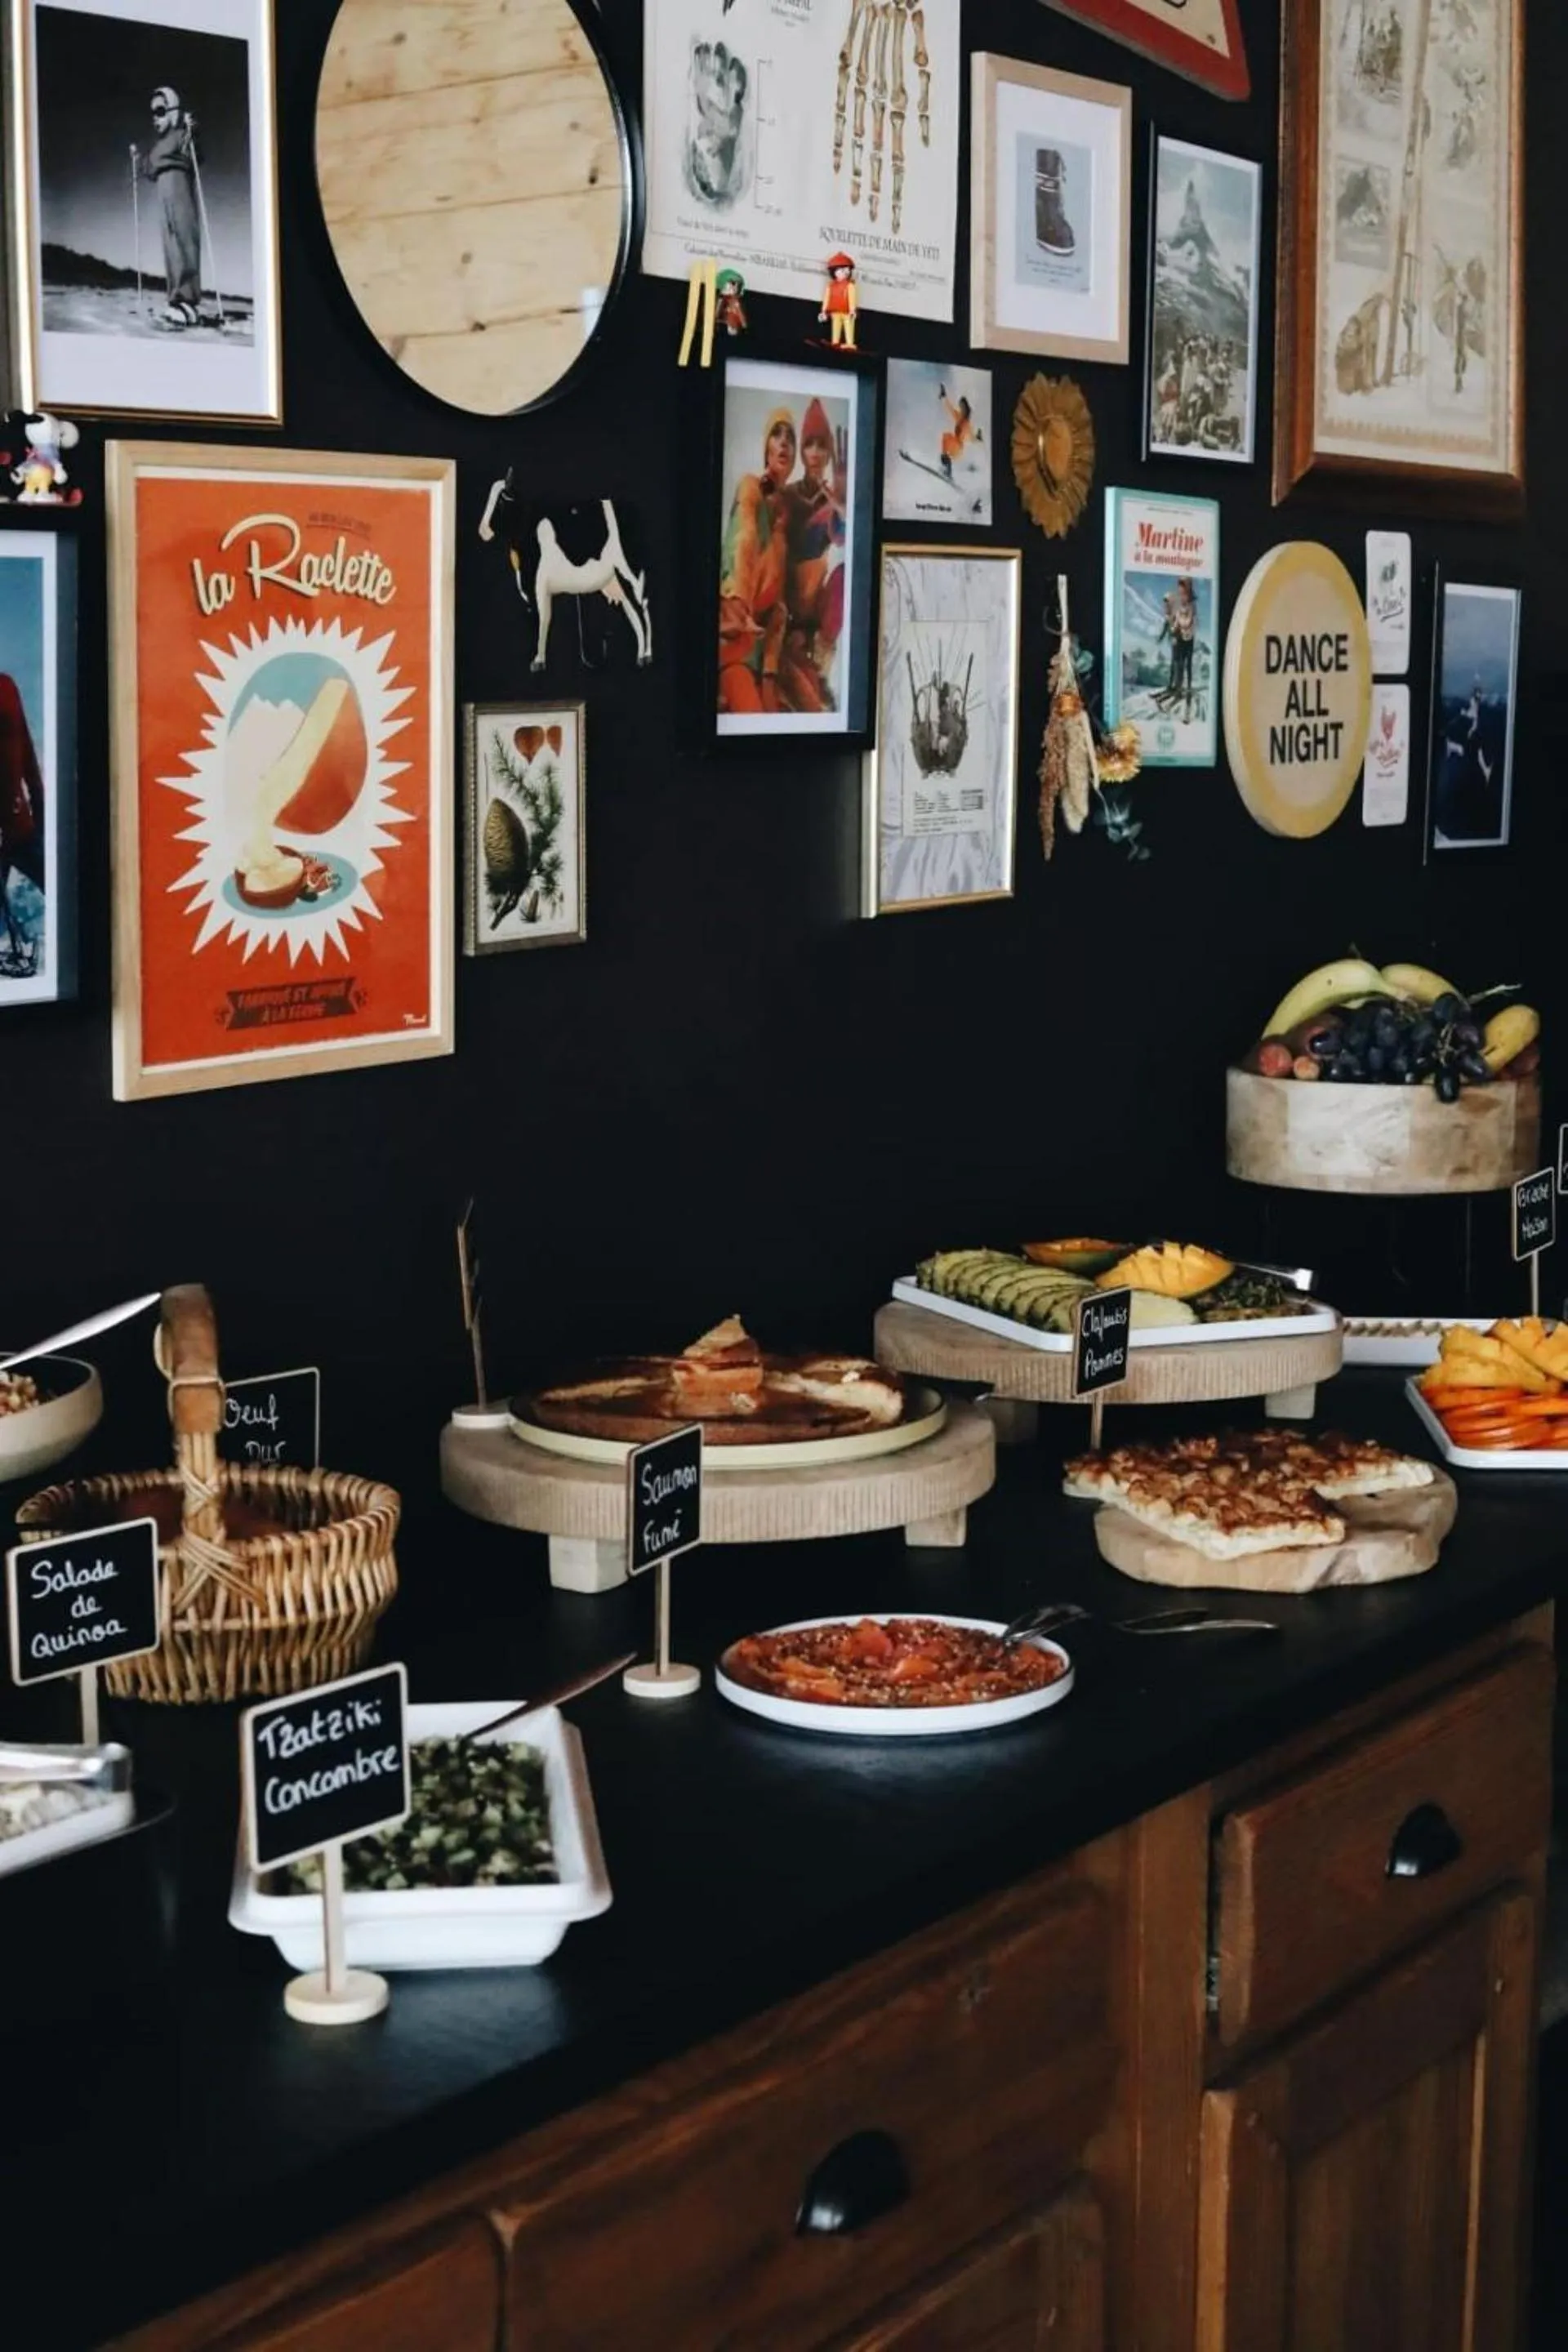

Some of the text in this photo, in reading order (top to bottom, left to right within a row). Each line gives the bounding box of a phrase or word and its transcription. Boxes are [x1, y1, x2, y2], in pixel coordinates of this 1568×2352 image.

[1135, 522, 1204, 552] Martine
[192, 513, 397, 615] la Raclette
[1265, 633, 1349, 674] DANCE
[1285, 679, 1330, 719] ALL
[1269, 721, 1344, 766] NIGHT
[641, 1463, 697, 1506] Saumon
[30, 1559, 119, 1599] Salade
[71, 1594, 103, 1618] de
[30, 1619, 127, 1659] Quinoa
[257, 1699, 382, 1759] Tzatziki
[264, 1745, 401, 1815] Concombre
